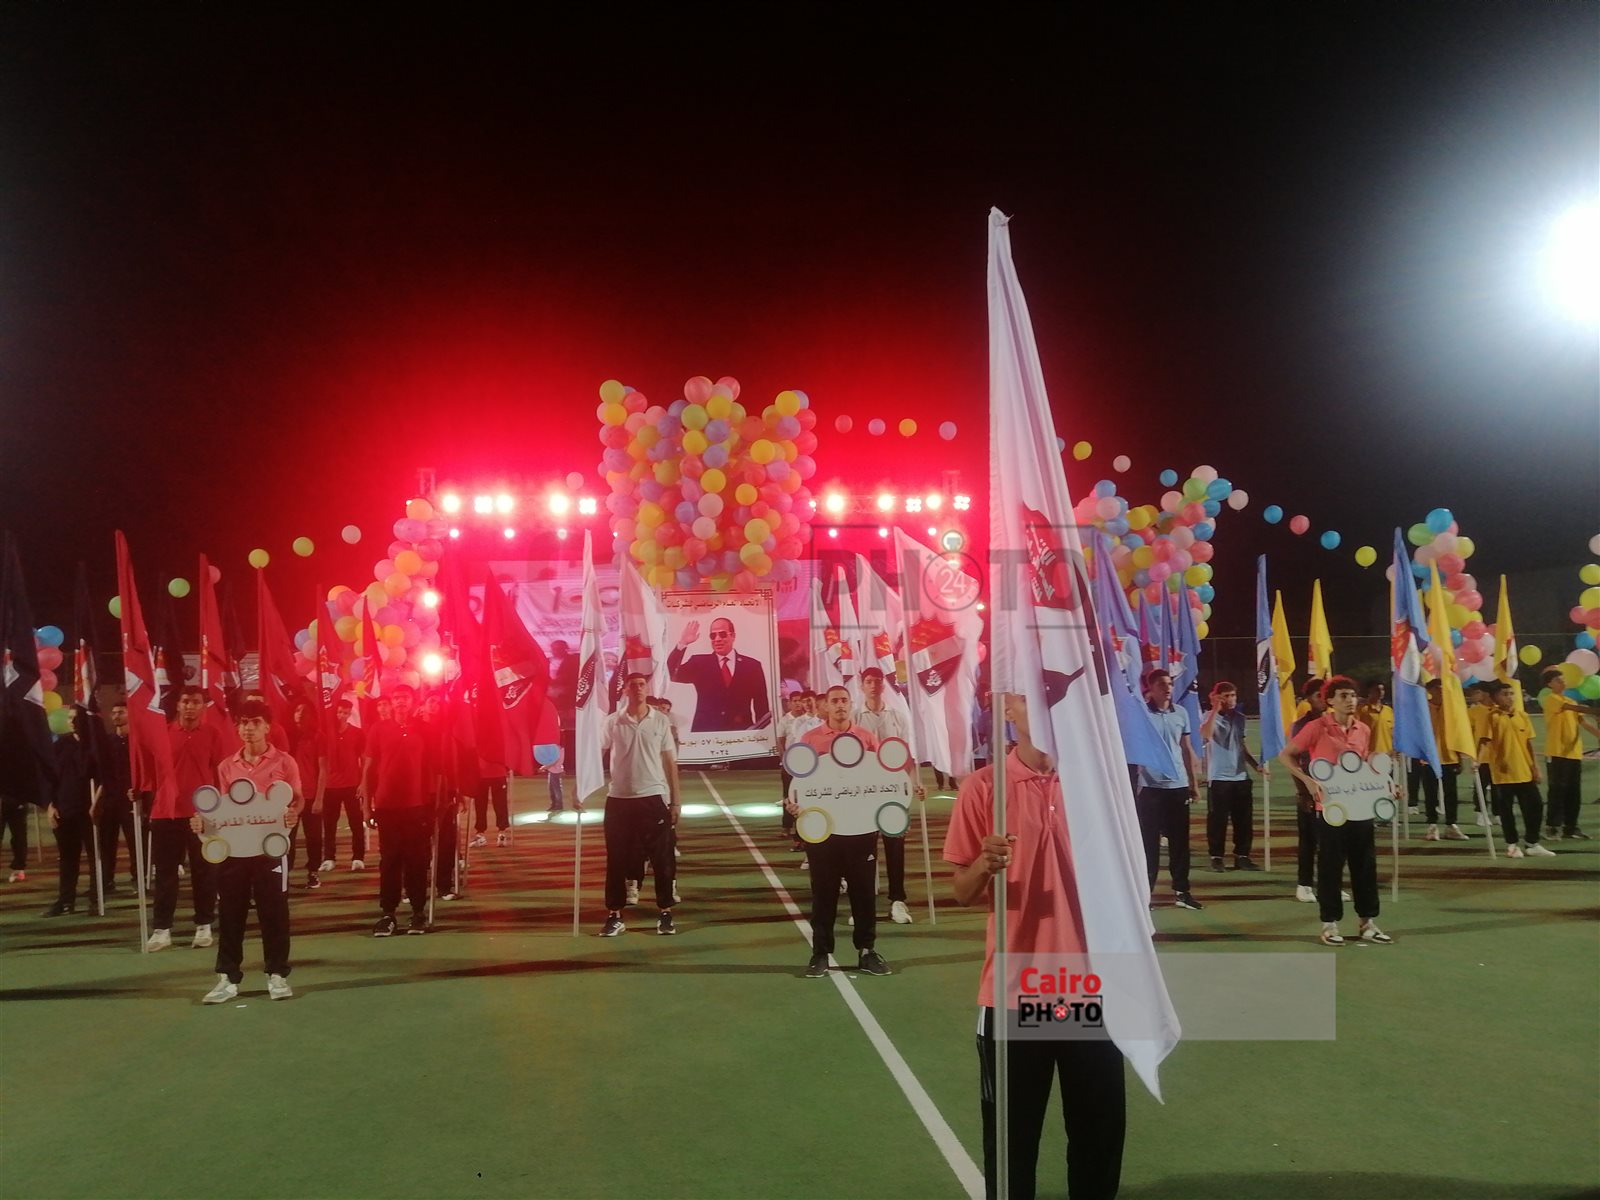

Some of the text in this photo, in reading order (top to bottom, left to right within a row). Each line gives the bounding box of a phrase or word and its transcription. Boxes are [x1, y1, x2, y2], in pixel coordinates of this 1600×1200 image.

[748, 735, 769, 744] بطولة
[863, 784, 877, 797] العام
[1360, 781, 1384, 792] منطقة
[804, 786, 833, 800] للشركات
[246, 814, 277, 826] منطقة
